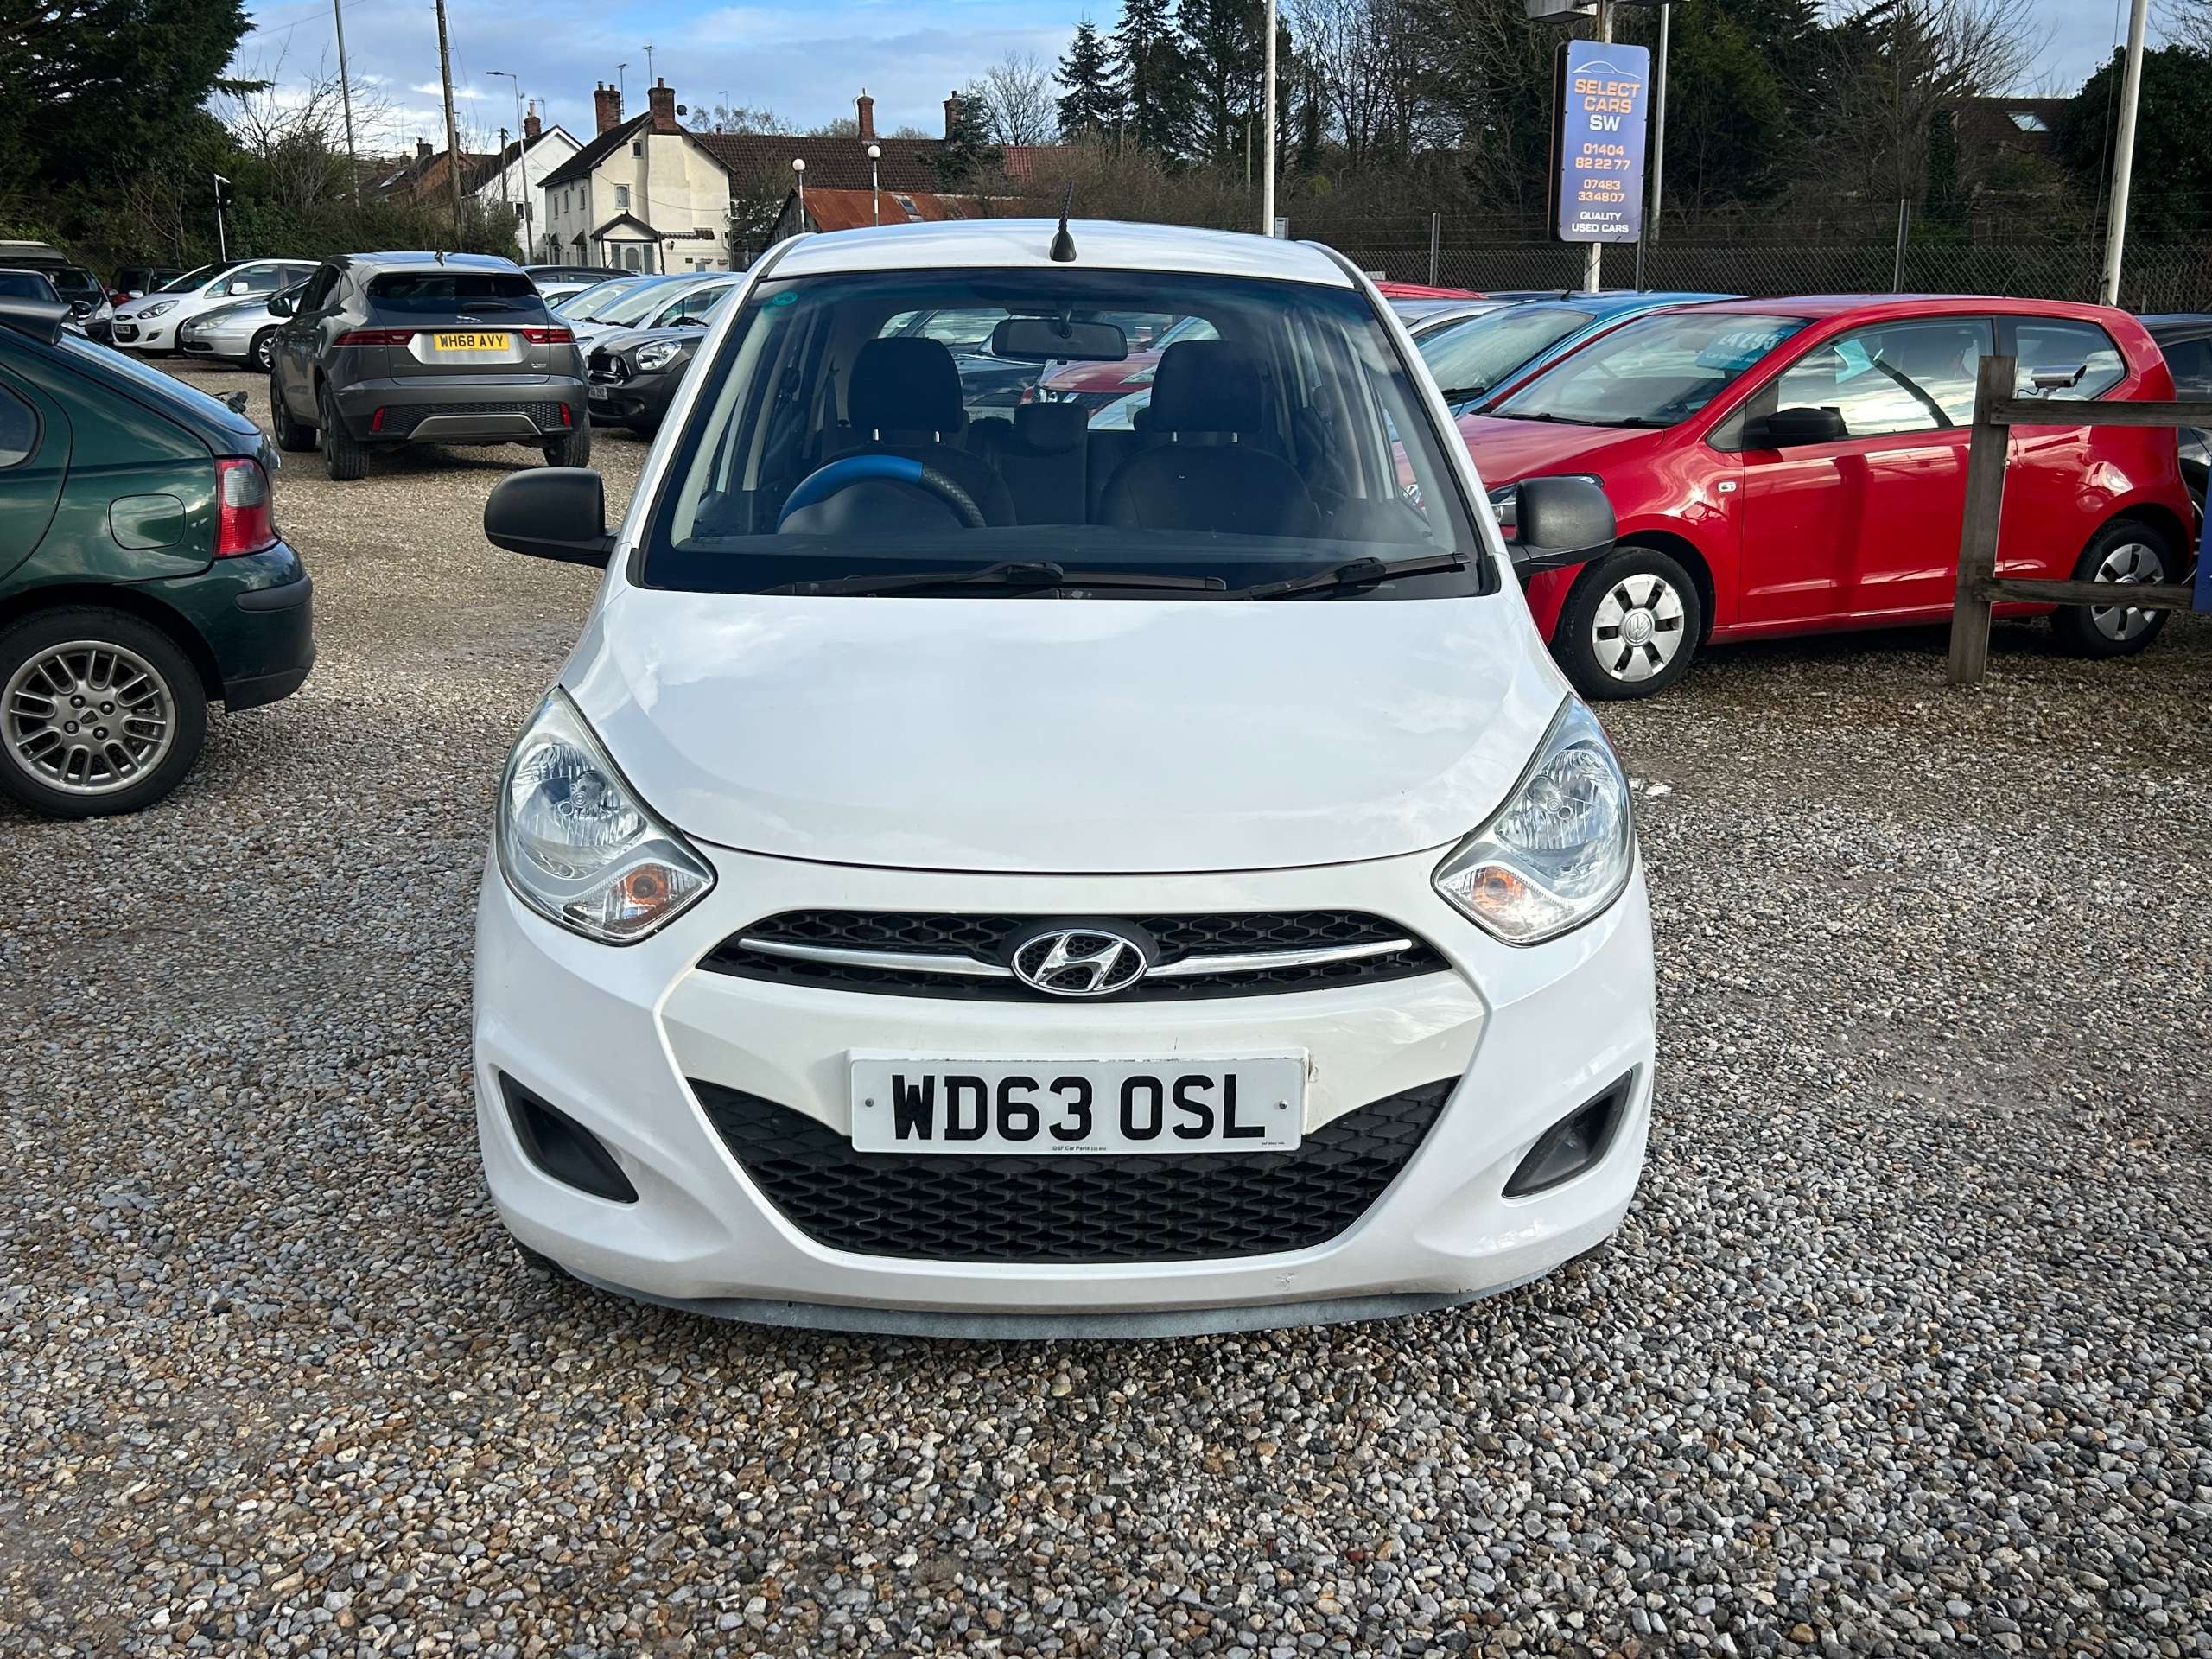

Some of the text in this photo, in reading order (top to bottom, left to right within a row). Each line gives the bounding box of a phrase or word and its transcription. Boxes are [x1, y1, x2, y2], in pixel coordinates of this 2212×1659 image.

[1575, 79, 1641, 99] SELECT
[1584, 96, 1632, 114] CARS
[1590, 114, 1621, 132] SW
[1583, 143, 1624, 156] 01404
[1584, 179, 1621, 190] 07483
[1578, 191, 1625, 202] 334807
[1580, 211, 1622, 221] QUALITY
[1571, 223, 1630, 233] USED CARS
[439, 335, 504, 347] WH68 AVY
[891, 1074, 1266, 1141] WD63 OSL
